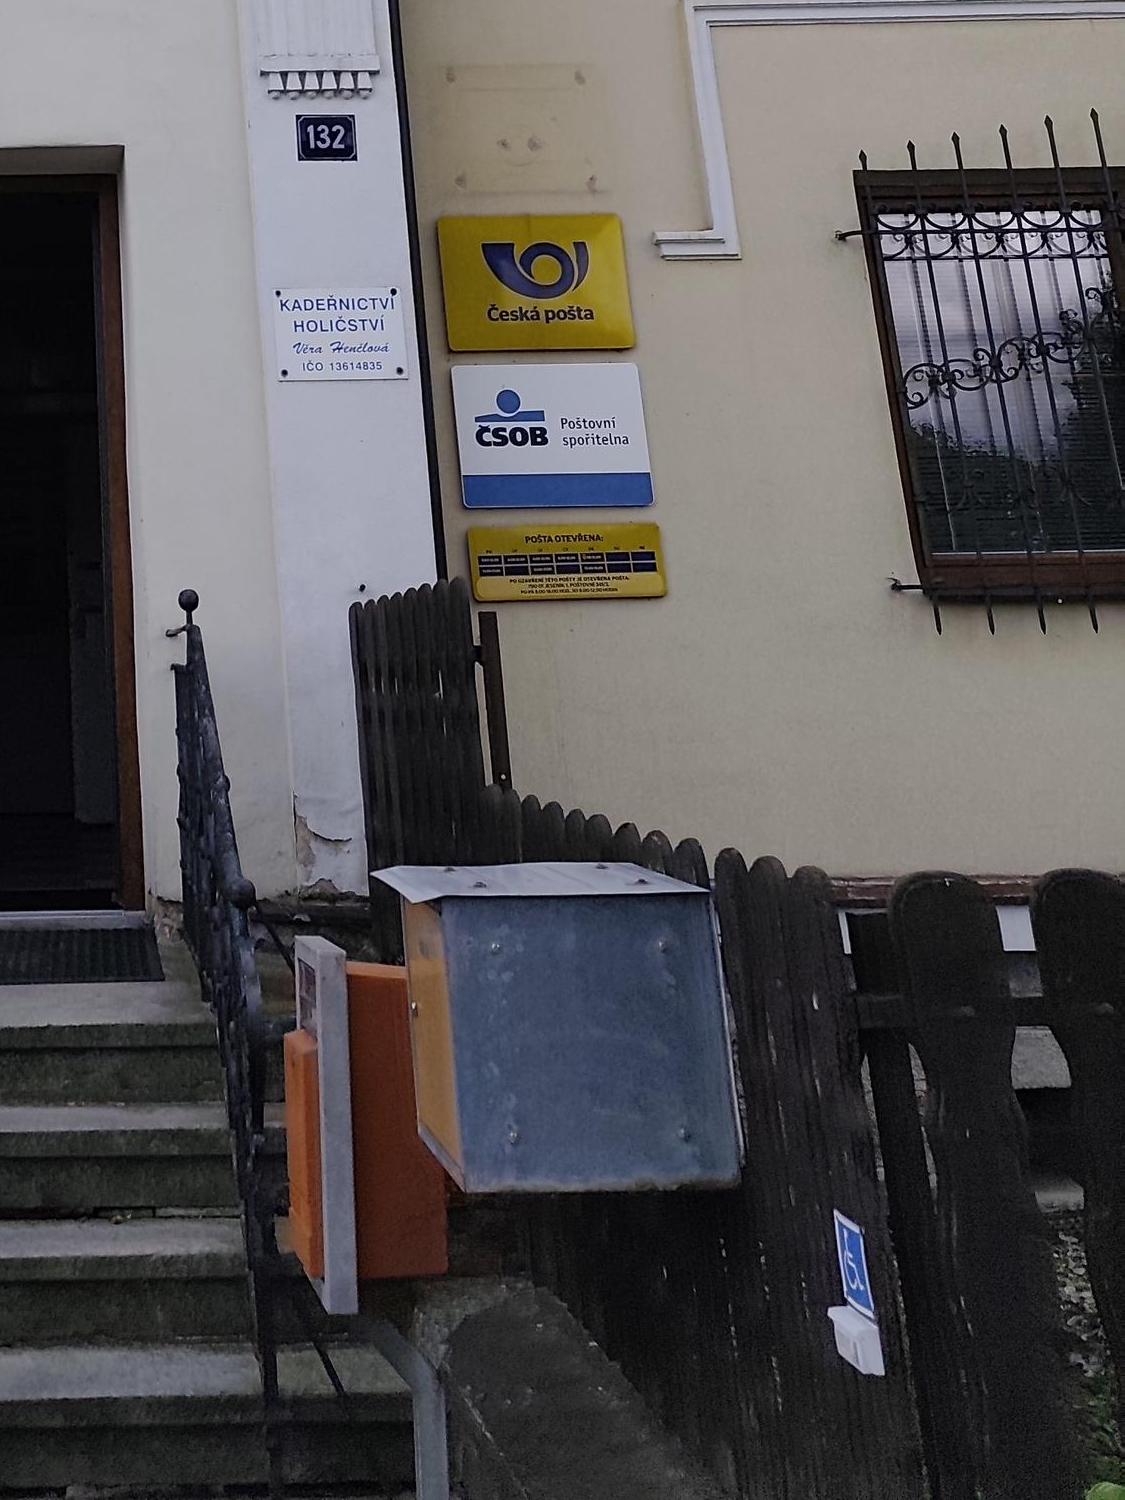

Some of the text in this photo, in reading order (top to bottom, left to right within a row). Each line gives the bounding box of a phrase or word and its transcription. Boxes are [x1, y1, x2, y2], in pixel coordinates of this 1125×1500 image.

[306, 124, 345, 149] 132
[279, 294, 395, 311] KADEŘNICTVÍ
[487, 303, 594, 324] Česká pošta
[293, 314, 384, 332] HOLIČSTVÍ
[293, 342, 323, 354] Věra
[302, 360, 383, 371] IČO 13614835
[560, 417, 616, 430] Poštovní
[475, 424, 549, 447] ČSOB
[562, 433, 630, 449] spořitelna
[524, 533, 604, 544] POŠTA OTEVŘENA:
